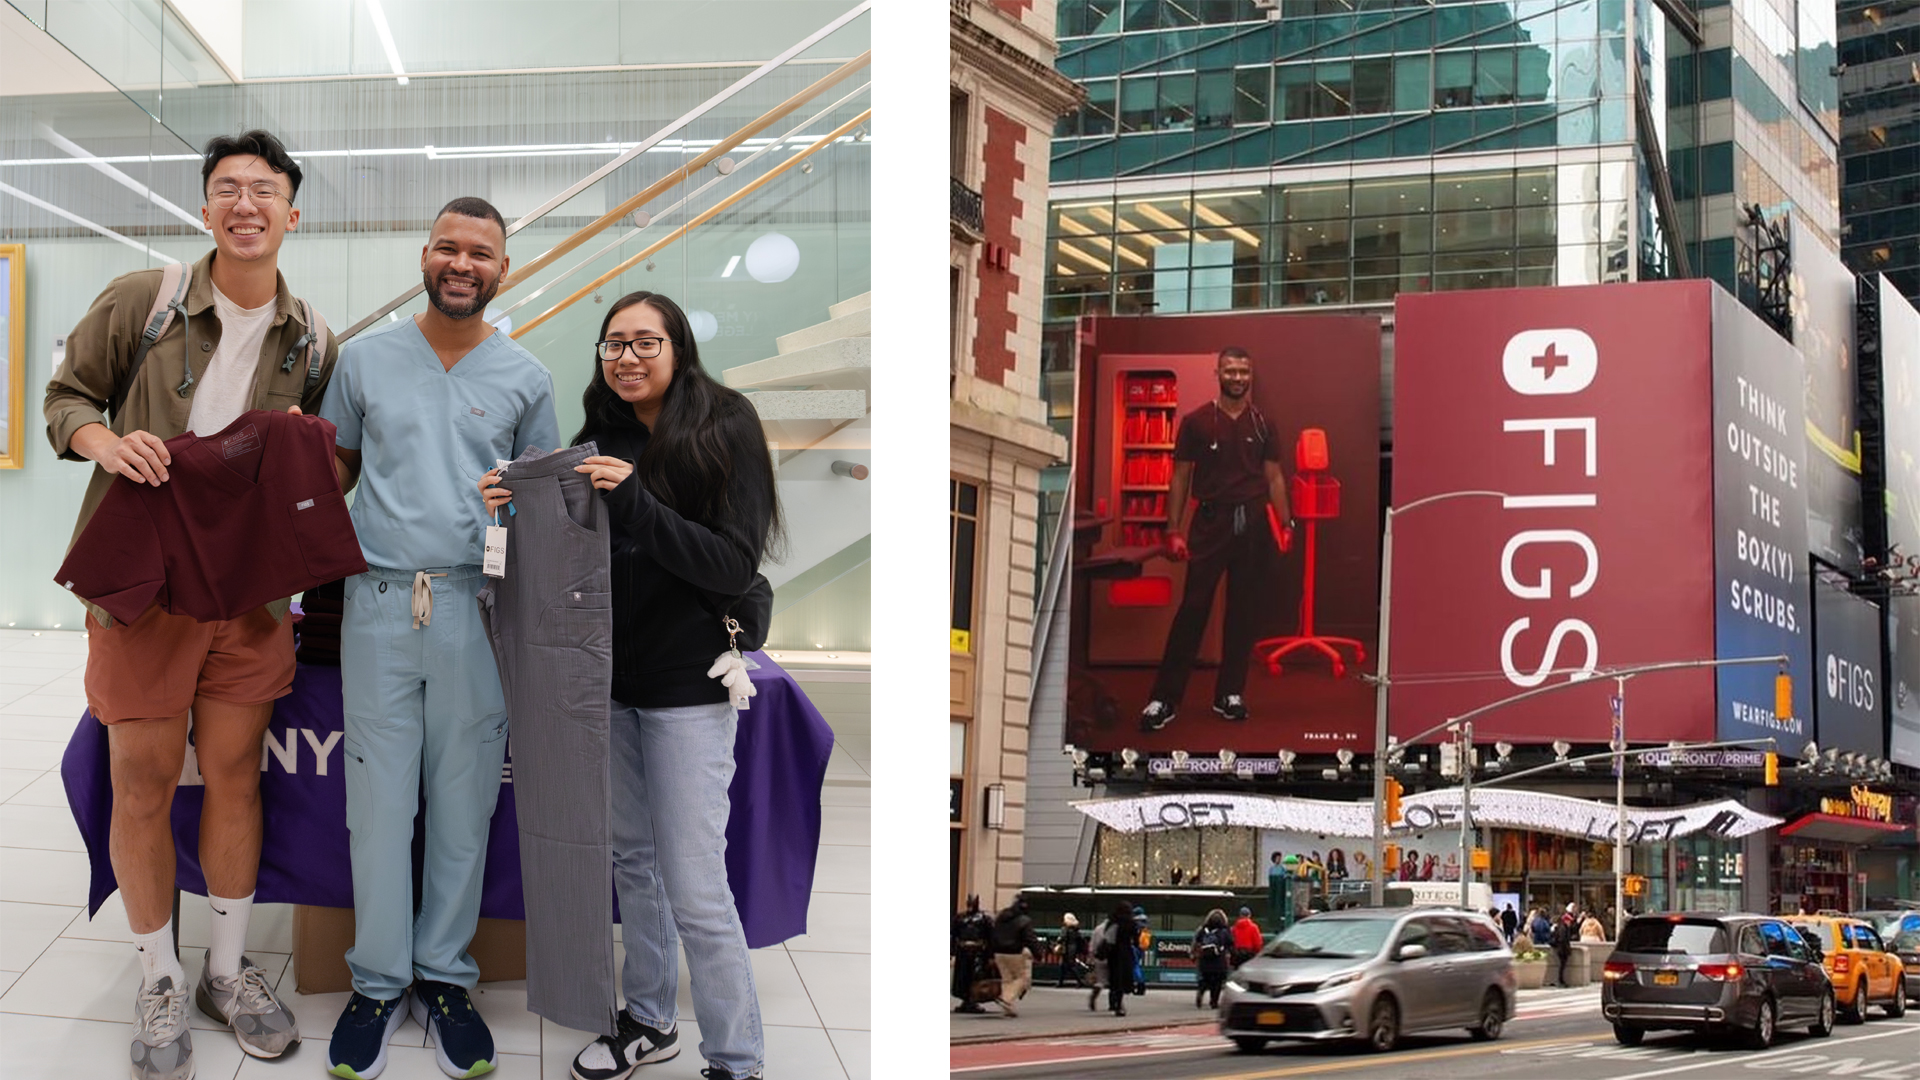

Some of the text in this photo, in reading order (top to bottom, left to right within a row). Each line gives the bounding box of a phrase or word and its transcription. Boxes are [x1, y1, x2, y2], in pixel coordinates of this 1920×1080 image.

[1737, 376, 1787, 436] THINK
[1727, 422, 1798, 489] OUTSIDE
[1749, 485, 1781, 528] THE
[490, 545, 505, 555] FIGS
[1501, 417, 1599, 688] FIGS
[1737, 528, 1794, 584] BOX(Y)
[1731, 579, 1800, 635] SCRUBS.
[1839, 658, 1875, 712] FIGS
[1237, 761, 1277, 772] PRIME
[1725, 753, 1762, 764] PRIME
[1139, 802, 1234, 828] LOFT
[1586, 815, 1687, 846] LOFT
[1158, 941, 1192, 954] Subway
